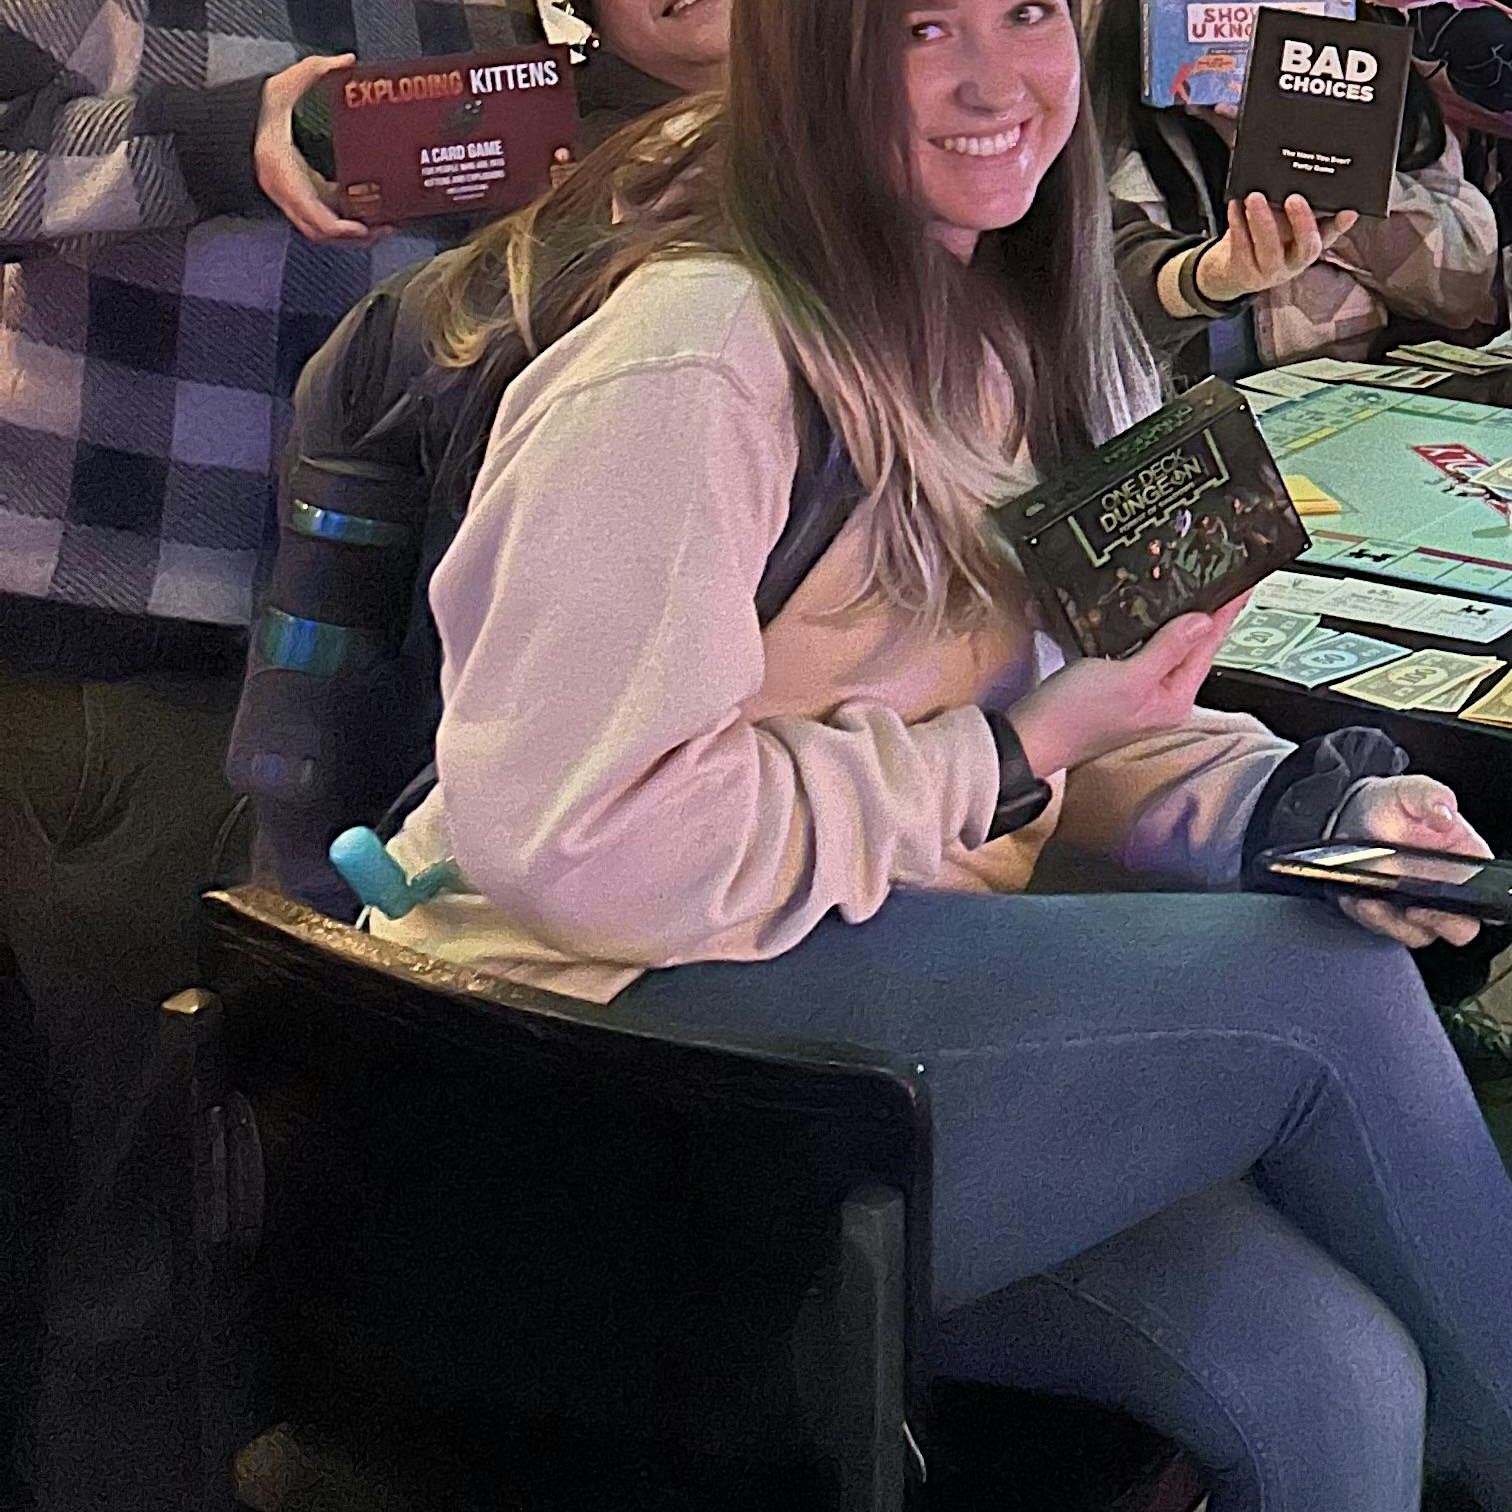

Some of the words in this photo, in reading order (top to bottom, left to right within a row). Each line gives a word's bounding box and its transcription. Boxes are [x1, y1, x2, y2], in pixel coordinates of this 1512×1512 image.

[1192, 24, 1206, 39] U
[1280, 39, 1378, 83] BAD
[345, 71, 463, 108] EXPLODING
[469, 60, 559, 94] KITTENS
[1279, 73, 1375, 103] CHOICES
[420, 149, 430, 165] A
[431, 144, 465, 163] CARD
[467, 139, 503, 159] GAME
[1099, 455, 1204, 534] DUNGEON
[1101, 479, 1137, 511] ONE
[1138, 448, 1185, 485] DECK
[1397, 668, 1437, 683] 100
